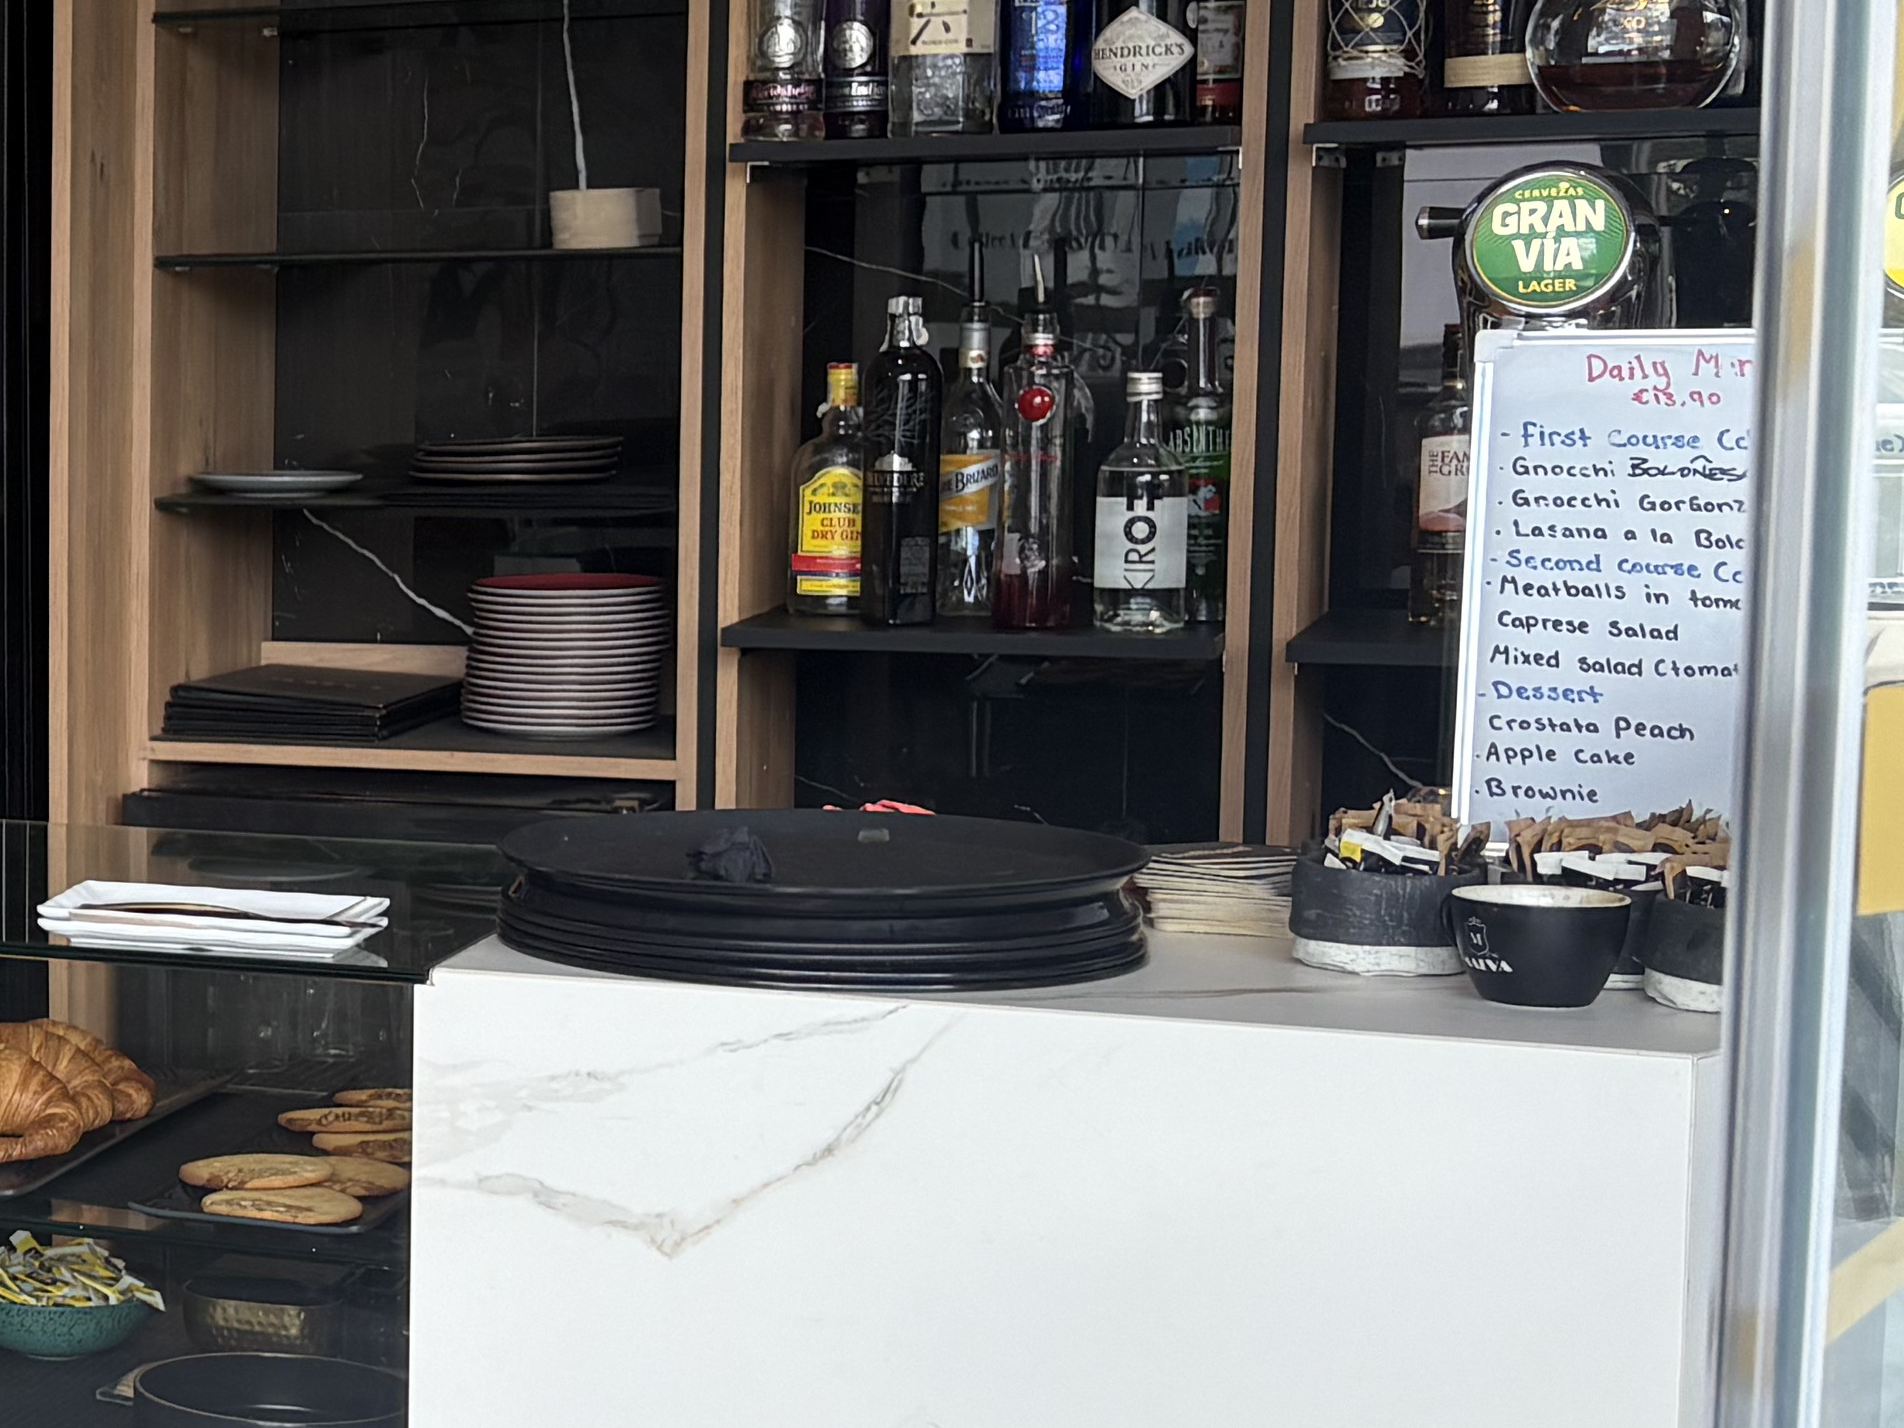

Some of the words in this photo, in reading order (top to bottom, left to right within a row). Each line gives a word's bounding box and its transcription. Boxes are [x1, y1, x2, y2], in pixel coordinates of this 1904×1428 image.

[1491, 198, 1605, 236] GRAN
[1518, 278, 1577, 294] LAGER
[1586, 353, 1672, 392] Daily
[1439, 449, 1471, 464] FAM
[1511, 455, 1617, 478] Gnocchi
[1627, 454, 1748, 482] BOLOÑES
[807, 499, 861, 516] JOHNSE
[1511, 488, 1621, 509] Gnocchi
[811, 529, 838, 541] DRY
[820, 517, 857, 528] CLUB
[1513, 518, 1608, 540] Lasana
[1623, 528, 1638, 542] a
[1649, 527, 1674, 545] la
[1505, 548, 1603, 574] Second
[1499, 574, 1627, 601] Meatballs
[1644, 583, 1670, 606] in
[1497, 610, 1590, 636] Caprese
[1489, 643, 1561, 670] Mixed
[1491, 679, 1605, 704] Dessert
[1488, 714, 1601, 733] Crostata
[1613, 715, 1695, 742] Peach
[1485, 741, 1558, 767] Apple
[1484, 776, 1600, 804] Brownie
